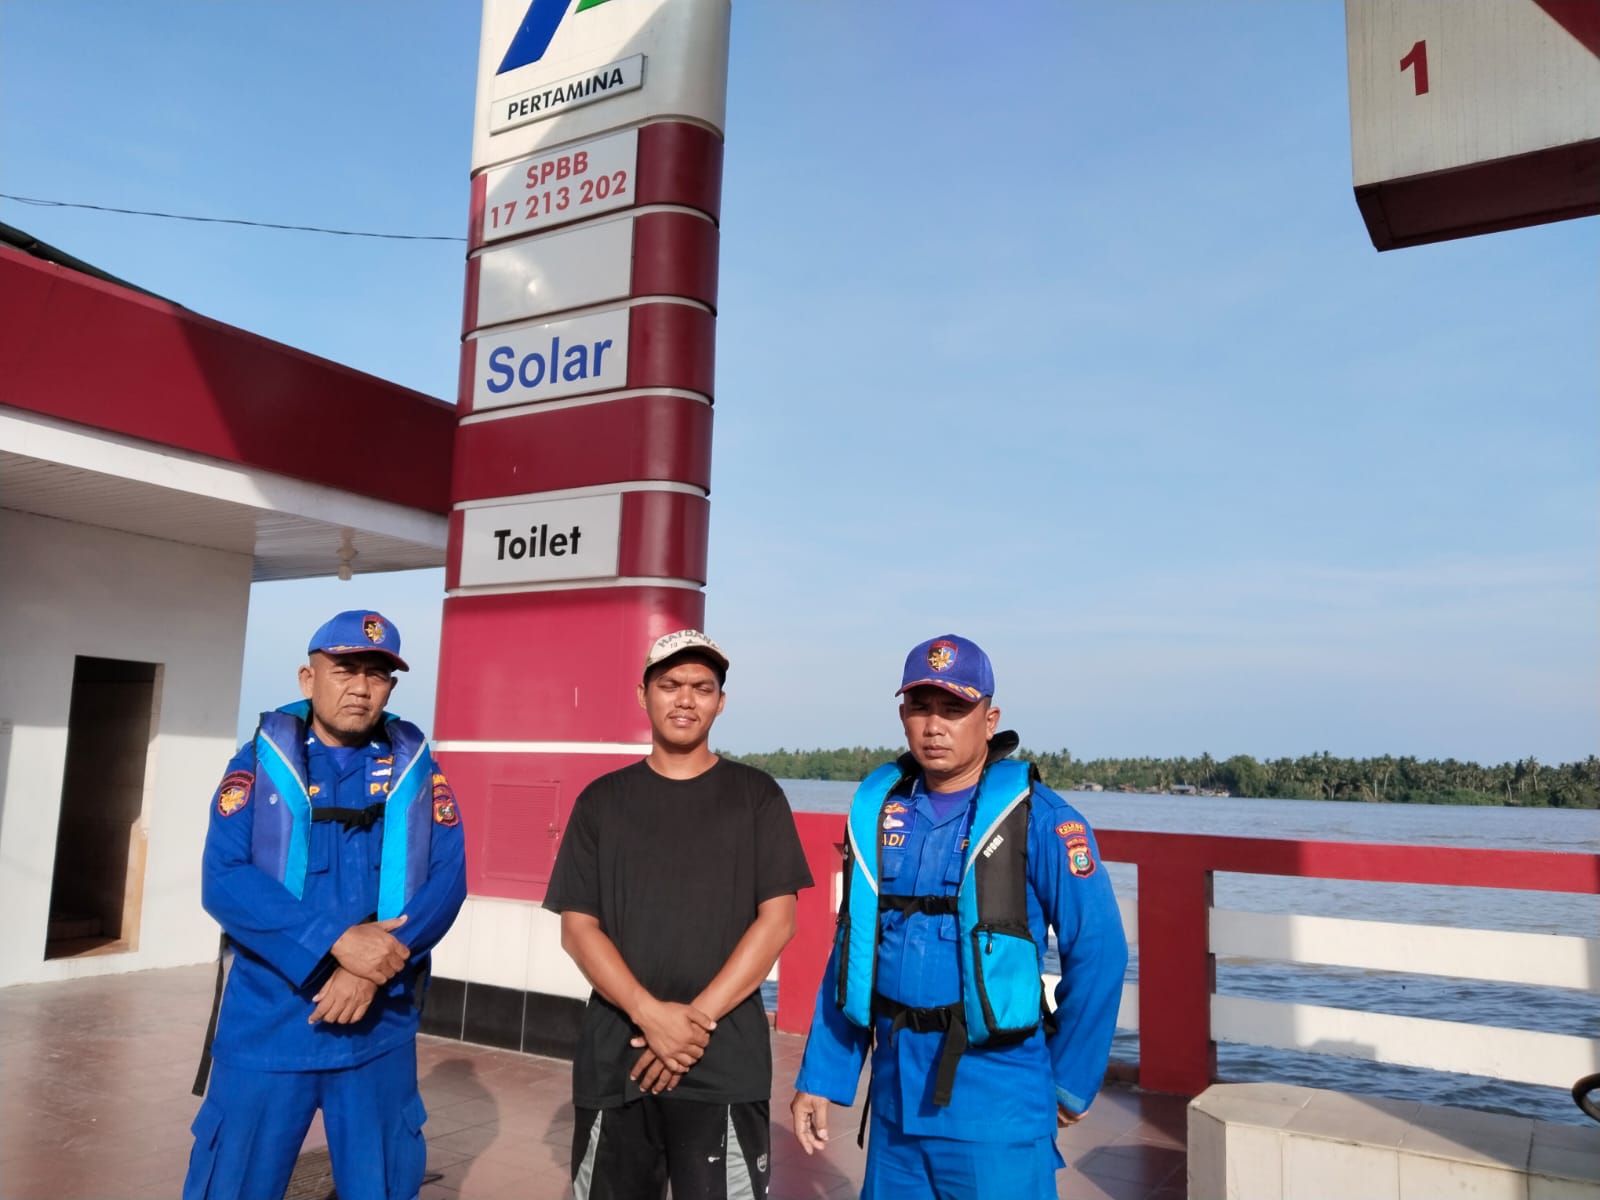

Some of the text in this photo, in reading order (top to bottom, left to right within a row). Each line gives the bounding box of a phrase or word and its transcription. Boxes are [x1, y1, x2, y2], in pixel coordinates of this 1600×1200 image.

[507, 67, 625, 120] PERTAMINA
[1400, 39, 1429, 96] 1
[525, 150, 589, 189] SPBB
[490, 169, 627, 229] 17 213 202
[486, 336, 613, 394] Solar
[494, 524, 582, 561] Toilet
